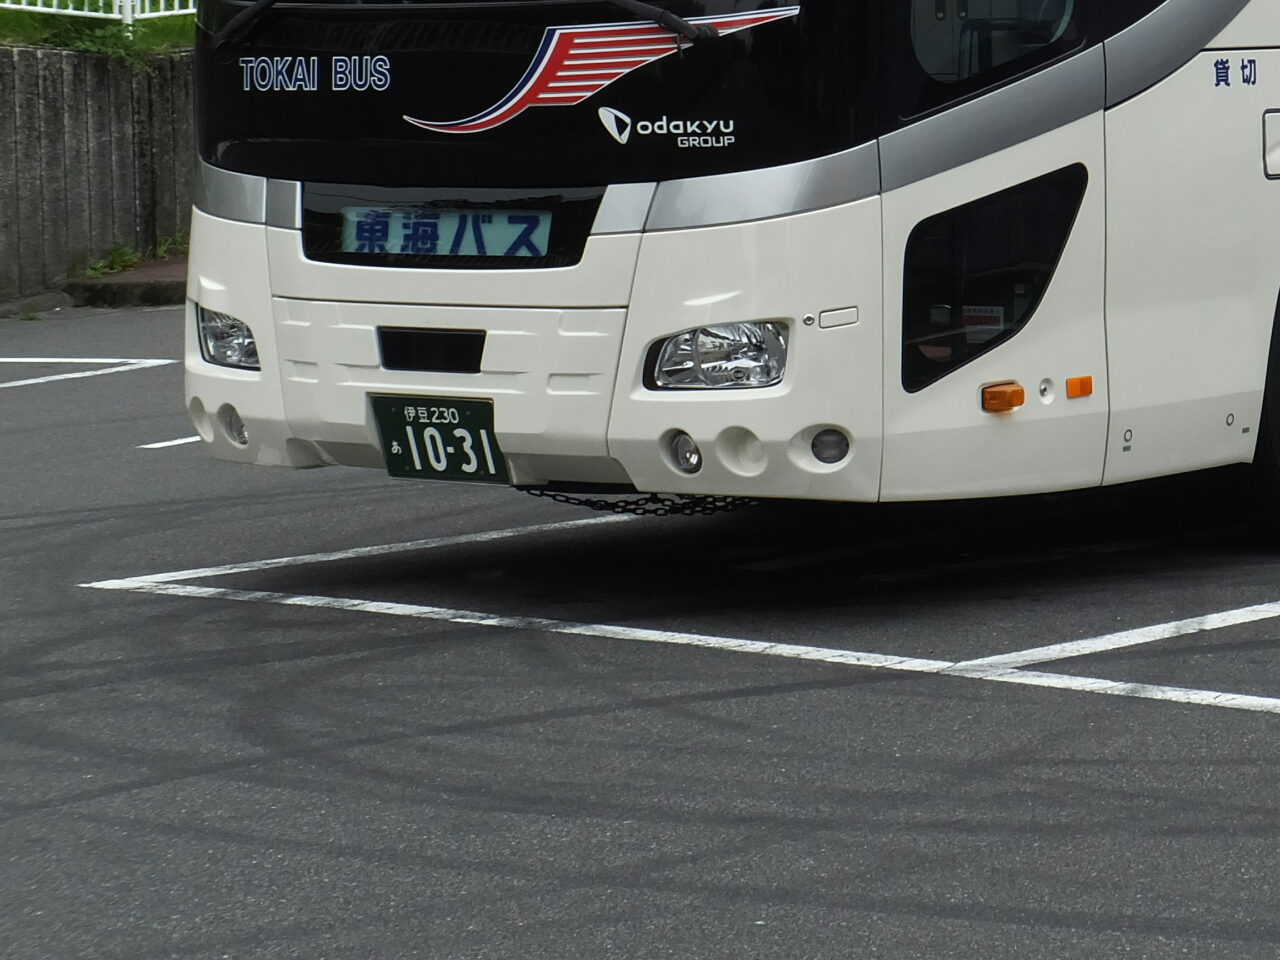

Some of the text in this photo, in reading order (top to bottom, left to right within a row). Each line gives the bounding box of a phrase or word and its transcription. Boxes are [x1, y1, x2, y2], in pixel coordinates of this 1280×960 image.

[239, 55, 391, 91] TOKAI BUS
[677, 136, 735, 147] GROUP
[351, 209, 546, 256] 東海バス
[405, 425, 496, 474] 10-31
